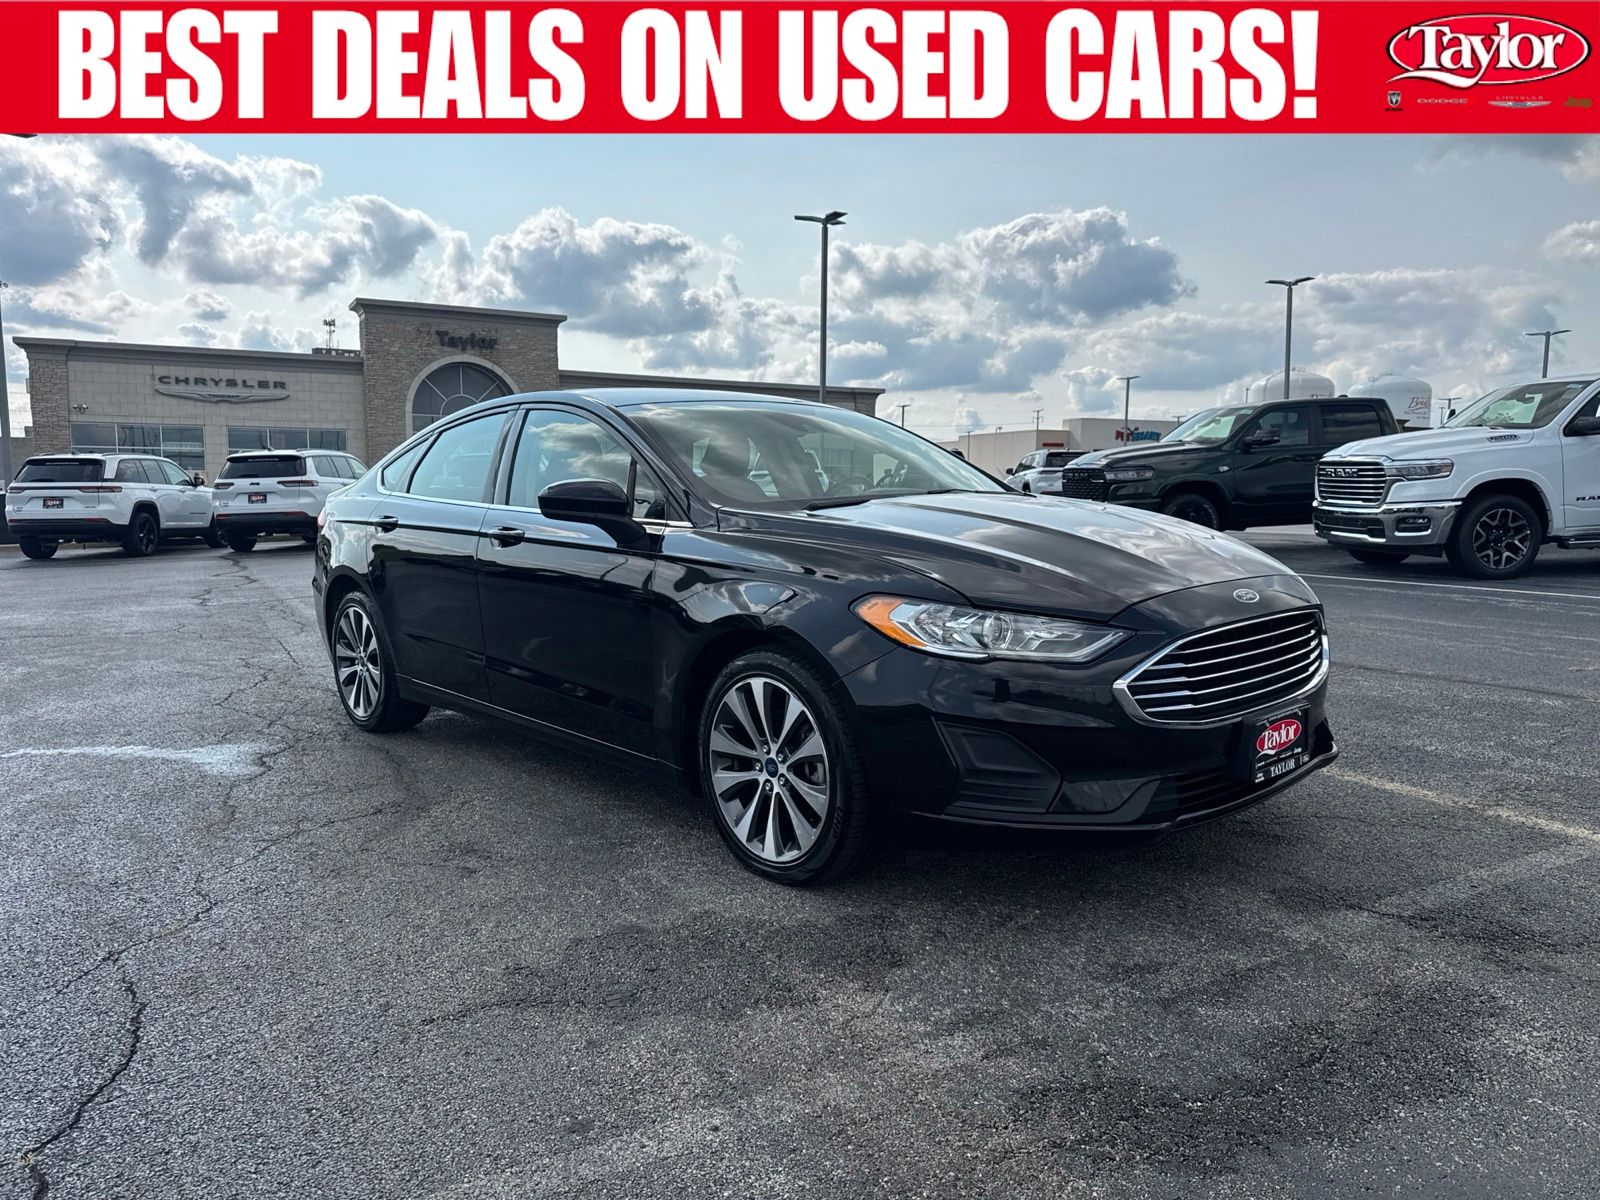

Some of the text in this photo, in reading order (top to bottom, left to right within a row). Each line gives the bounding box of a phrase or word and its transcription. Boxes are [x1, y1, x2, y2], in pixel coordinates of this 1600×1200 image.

[435, 330, 497, 351] Taylor
[158, 375, 287, 389] CHRYSLER
[1325, 468, 1358, 477] RAM
[1258, 723, 1298, 755] Taylor
[1270, 758, 1296, 777] TAYLOR
